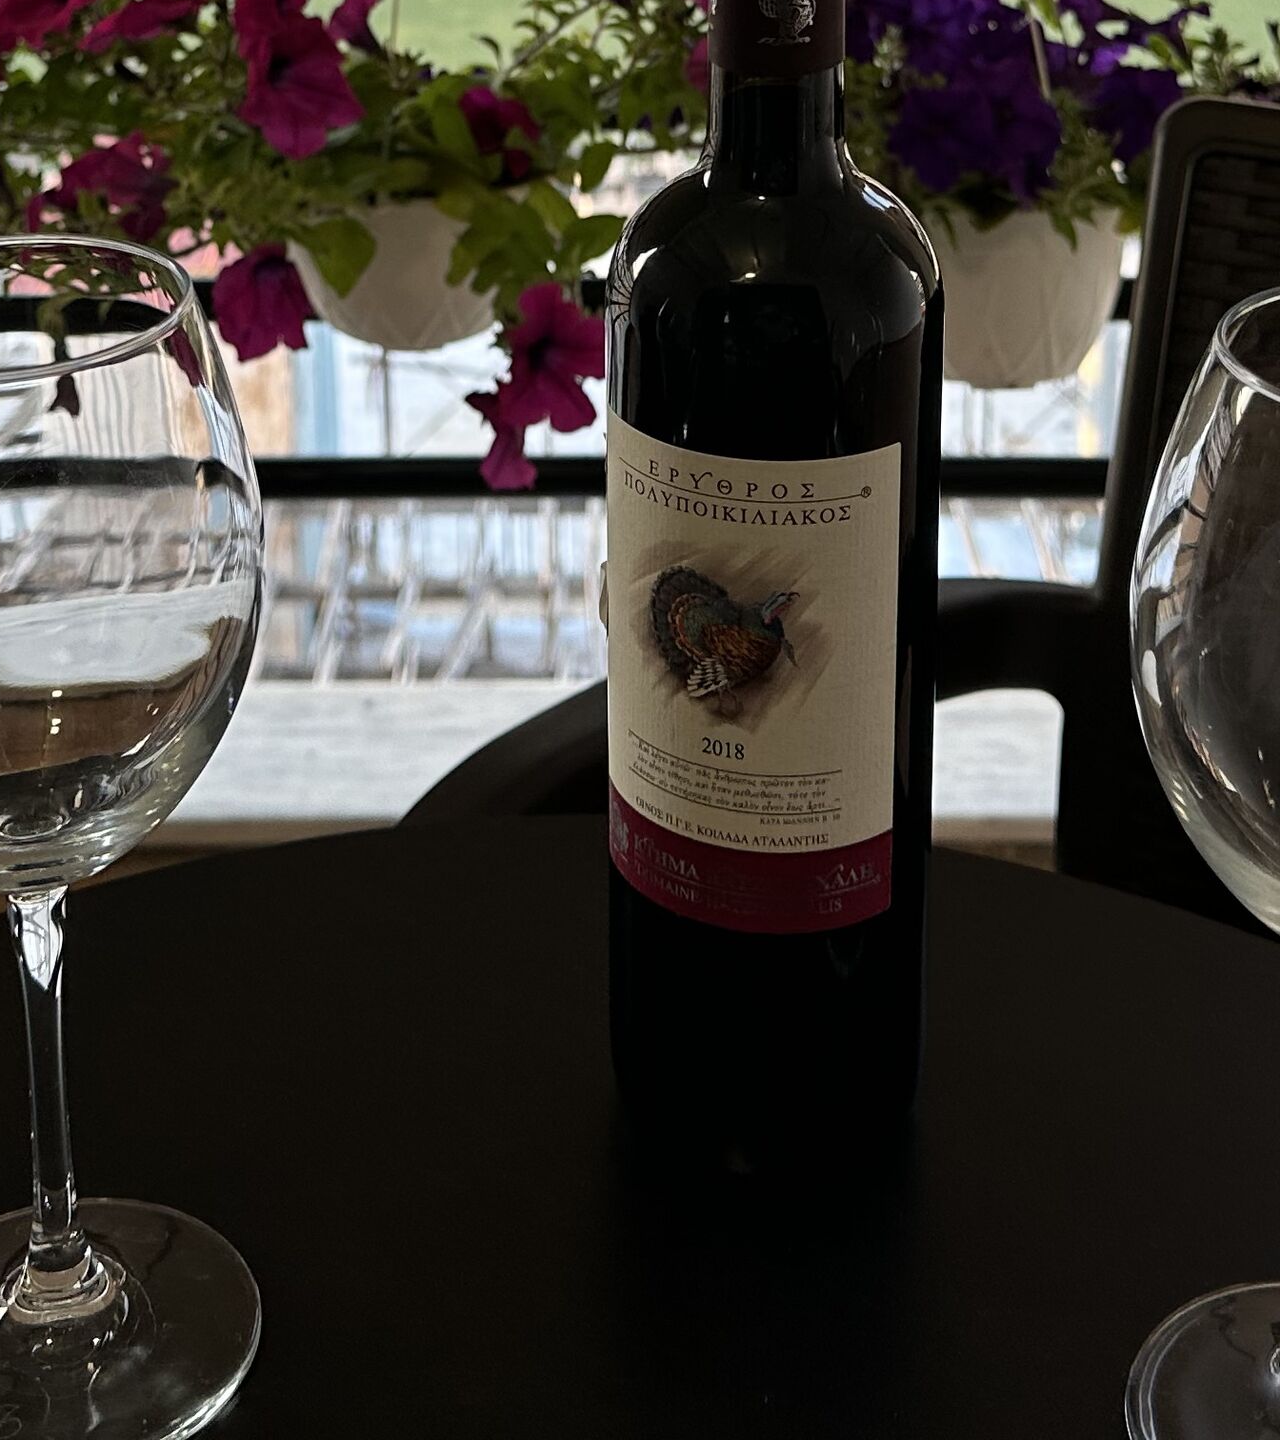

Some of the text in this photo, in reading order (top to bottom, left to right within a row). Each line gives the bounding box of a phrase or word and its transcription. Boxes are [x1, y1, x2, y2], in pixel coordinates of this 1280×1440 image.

[624, 470, 851, 526] ΠΟΛΥΠΟΙΚΙΛΙΑΚΟΣ
[648, 459, 815, 499] ΕΡΥΘΡΟΣ
[701, 736, 746, 760] 2018
[635, 796, 664, 820] ΟΙΝΟΣ
[696, 825, 749, 845] ΚΟΙΛΑΔΑ
[752, 833, 829, 847] ΑΤΑΛΑΝΤΗΣ
